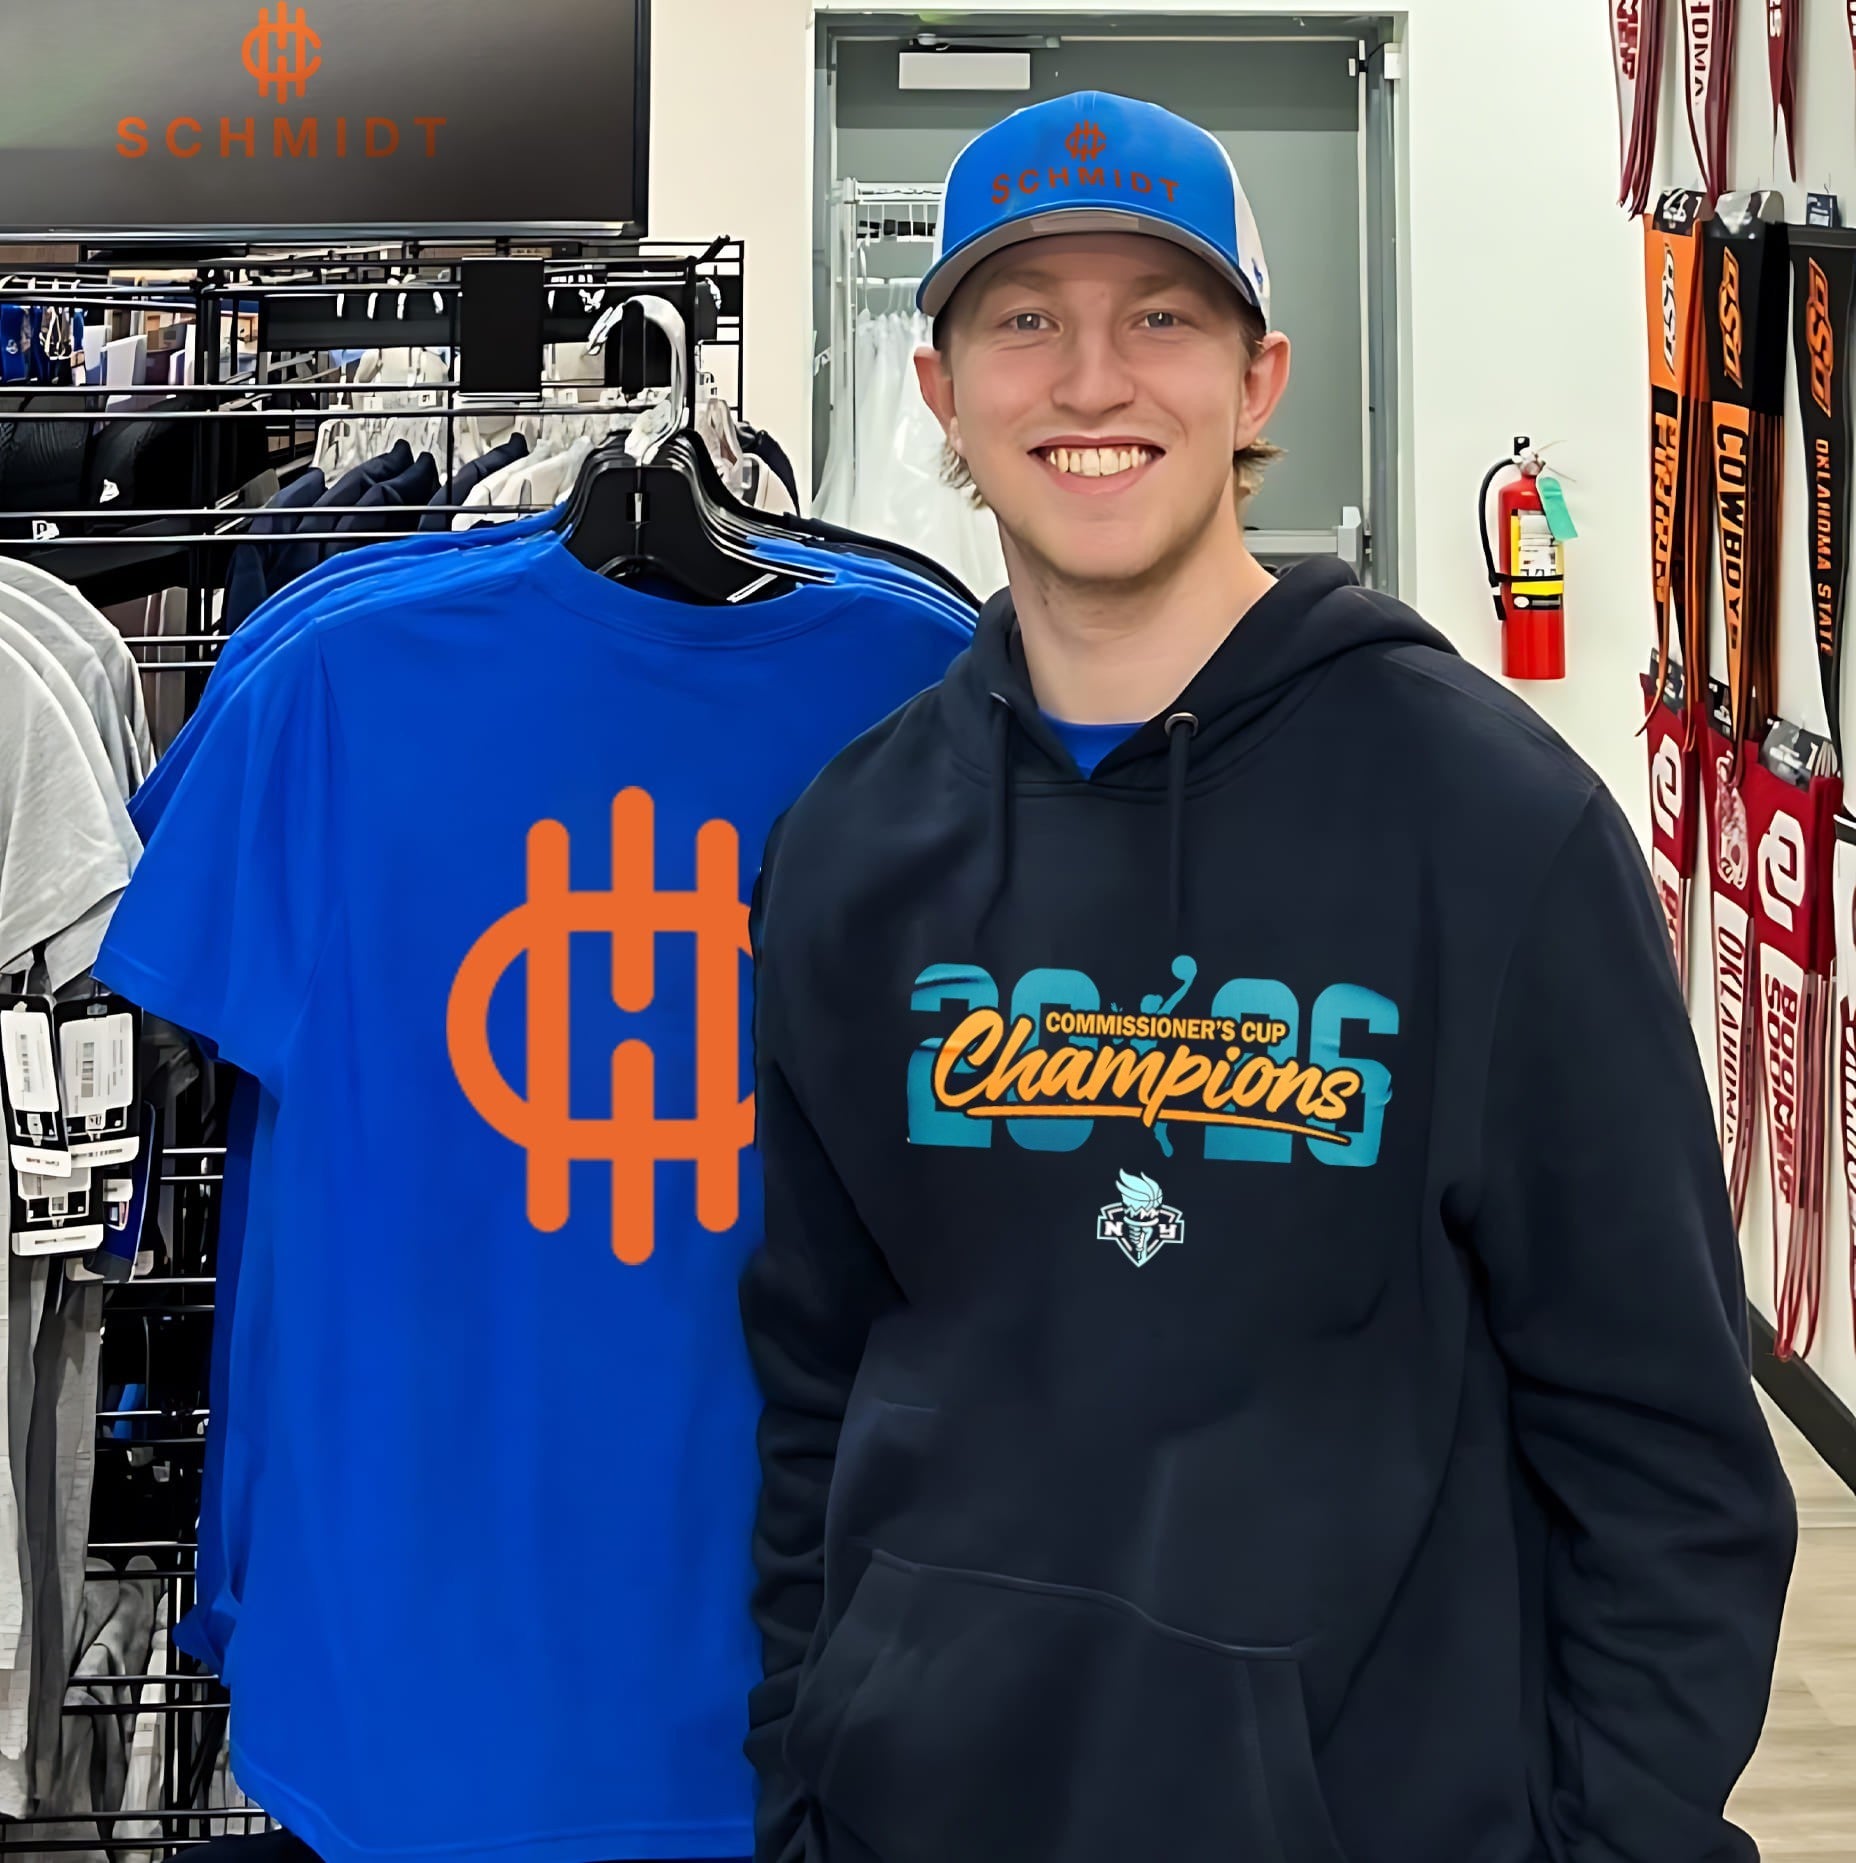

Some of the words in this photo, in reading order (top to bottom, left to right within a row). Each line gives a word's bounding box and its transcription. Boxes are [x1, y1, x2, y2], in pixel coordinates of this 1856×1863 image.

[115, 116, 448, 159] SCHMIDT
[991, 167, 1180, 204] SCHMIDT
[1815, 438, 1833, 571] OKLAHOMA
[1816, 582, 1834, 657] STATE
[1044, 1010, 1237, 1043] COMMISSIONER'S
[1240, 1019, 1287, 1044] CUP
[1718, 926, 1746, 1144] OKLAHOMA
[934, 1008, 1361, 1128] Champions
